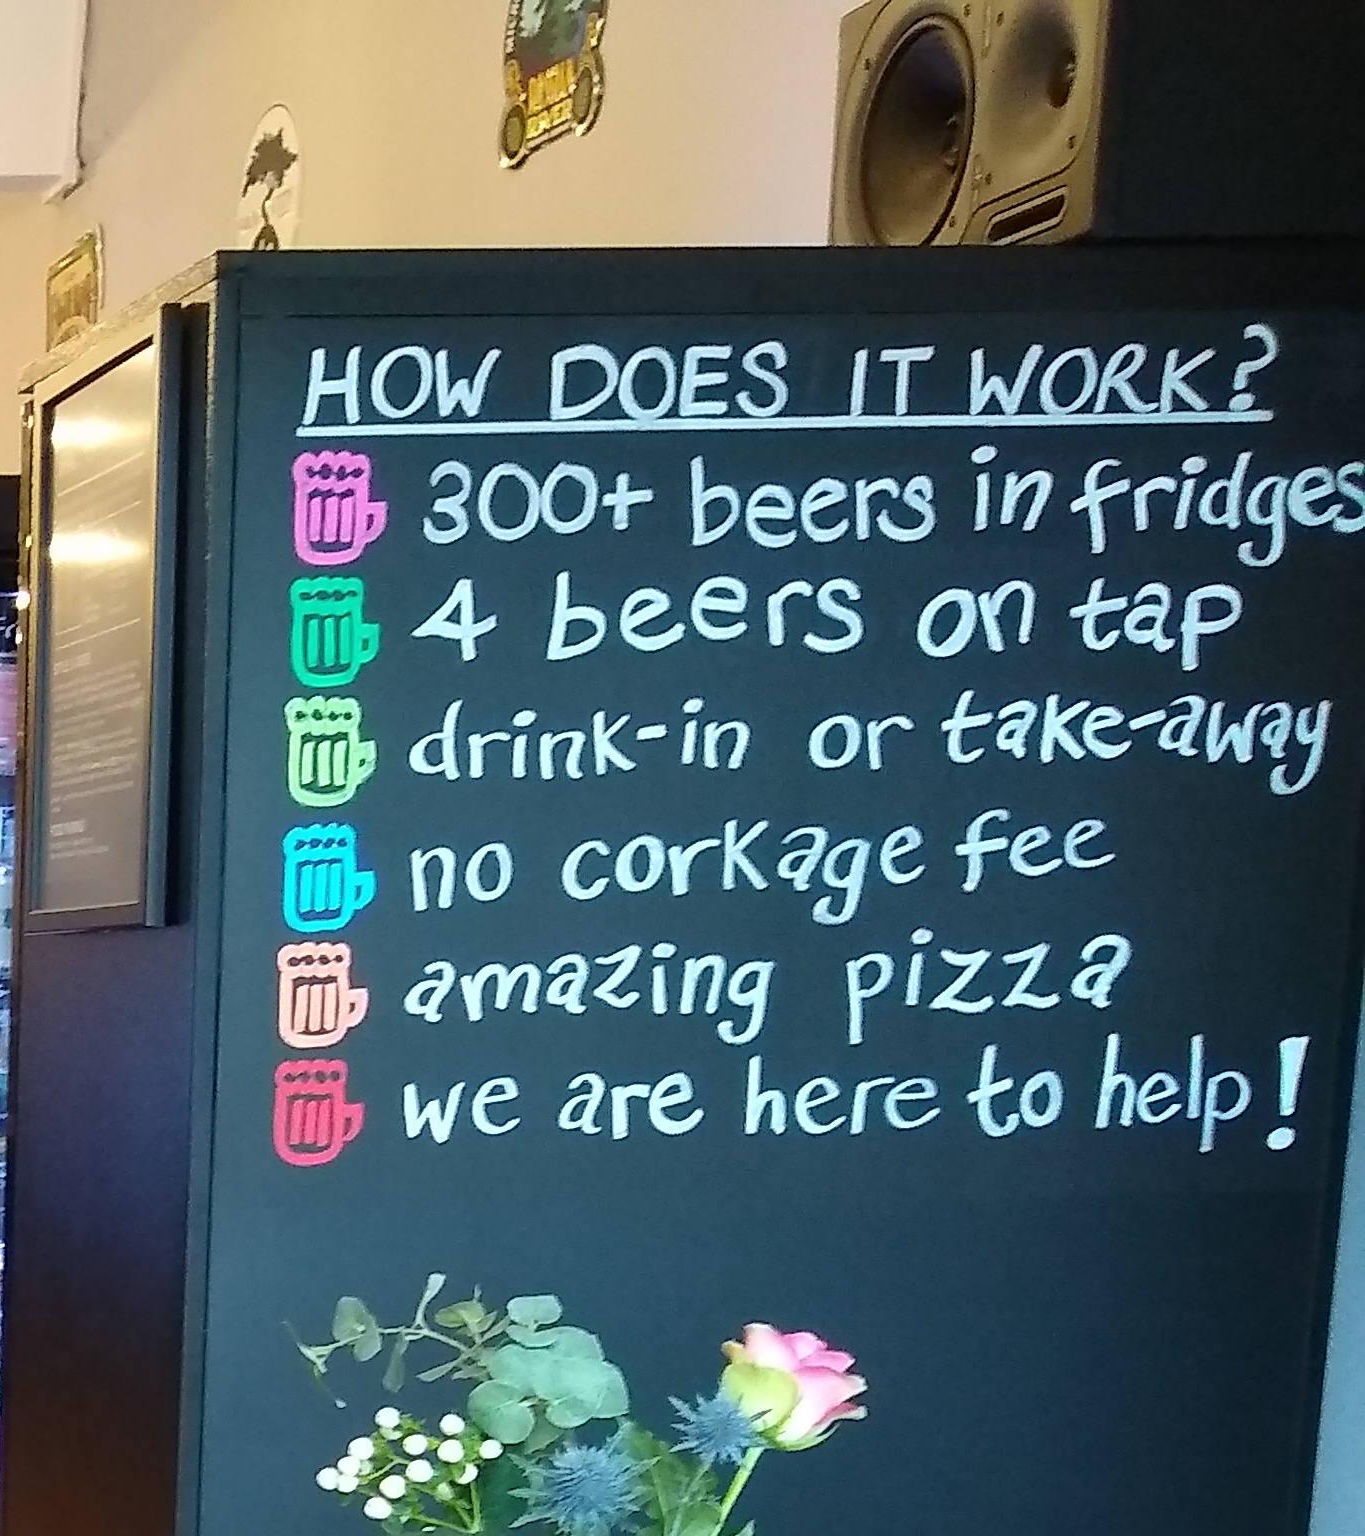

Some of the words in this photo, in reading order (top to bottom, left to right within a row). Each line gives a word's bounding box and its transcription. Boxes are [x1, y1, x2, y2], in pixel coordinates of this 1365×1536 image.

[301, 344, 503, 421] HOW
[549, 341, 790, 419] DOES
[850, 346, 934, 417] IT
[971, 323, 1279, 414] WORK?
[422, 460, 654, 544] 300+
[690, 455, 936, 549] beers
[971, 445, 1054, 533] in
[1069, 451, 1365, 567] fridges
[410, 577, 498, 662] 4
[546, 572, 864, 662] beers
[917, 579, 1037, 658] on
[1069, 577, 1243, 672] tap
[408, 698, 751, 781] drink-in
[808, 713, 914, 770] or
[940, 688, 1332, 796] take-away
[410, 842, 514, 912] no
[560, 819, 926, 925] corkage
[956, 808, 1117, 893] fee
[403, 943, 776, 1045] amazing
[845, 927, 1132, 1045] pizza
[403, 1077, 521, 1144] we
[557, 1072, 706, 1140] are
[744, 1054, 941, 1136] here
[966, 1043, 1064, 1138] to
[1094, 1034, 1311, 1154] help!
